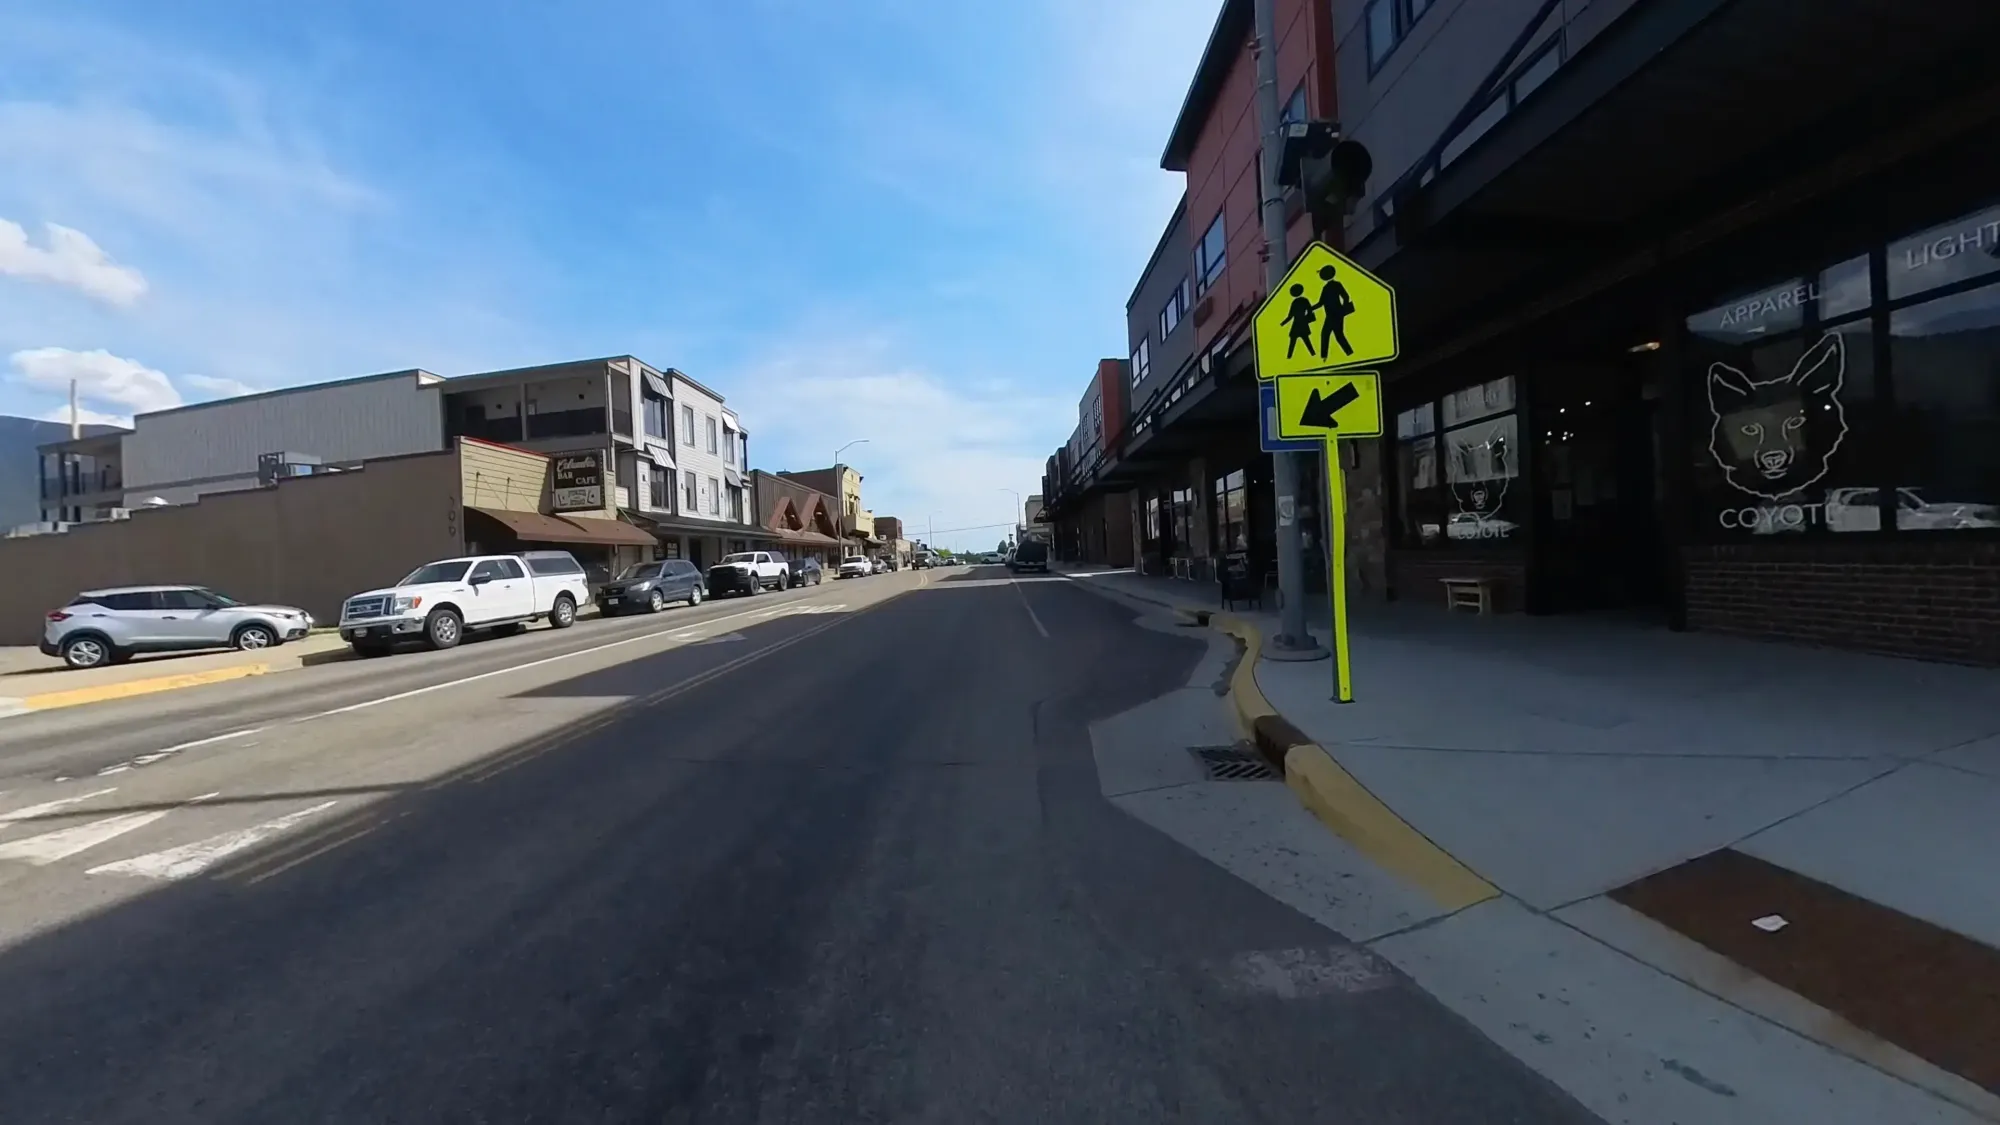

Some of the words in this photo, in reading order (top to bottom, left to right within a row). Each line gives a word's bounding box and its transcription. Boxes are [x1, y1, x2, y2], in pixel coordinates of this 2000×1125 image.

[1719, 283, 1821, 328] APPAREL
[557, 471, 573, 480] BAR
[575, 476, 597, 485] CAFE
[1457, 526, 1509, 540] COYOTE
